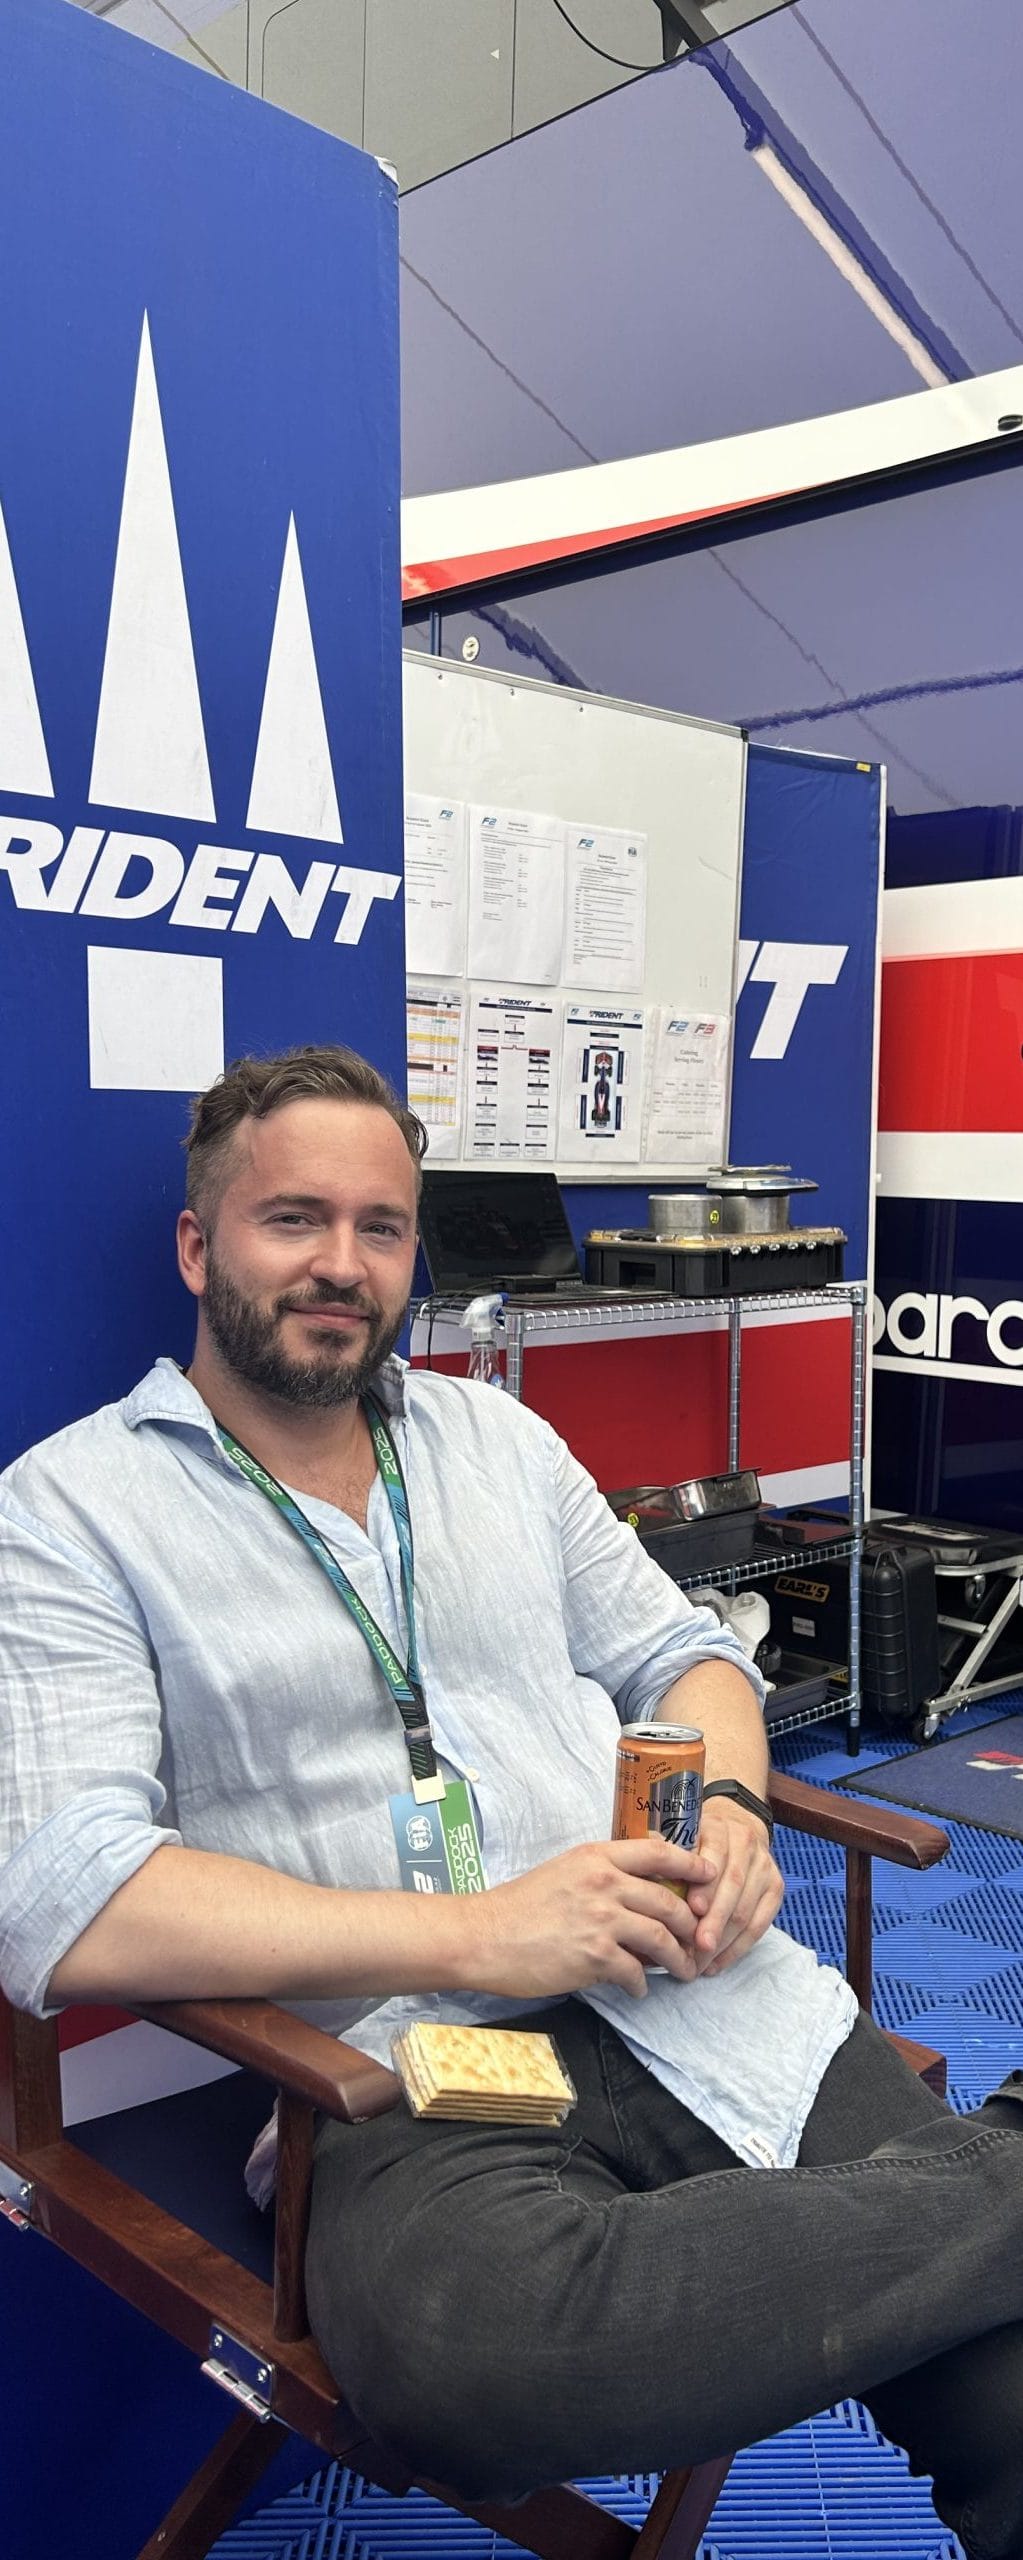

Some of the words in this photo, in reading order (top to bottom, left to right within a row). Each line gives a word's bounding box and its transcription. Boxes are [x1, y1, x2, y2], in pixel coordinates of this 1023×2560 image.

[482, 817, 498, 826] F2
[579, 838, 595, 848] F2
[738, 939, 849, 1059] T
[589, 1010, 624, 1020] TRIDENT
[668, 1020, 689, 1032] F2
[694, 1023, 716, 1035] F3
[373, 1426, 398, 1475] 2025
[228, 1447, 283, 1496] 2025
[777, 1578, 827, 1600] EARL'S
[352, 1599, 402, 1684] PADDOCK
[636, 1796, 660, 1812] SAN
[663, 1799, 700, 1813] BENED
[458, 1823, 482, 1894] 2025
